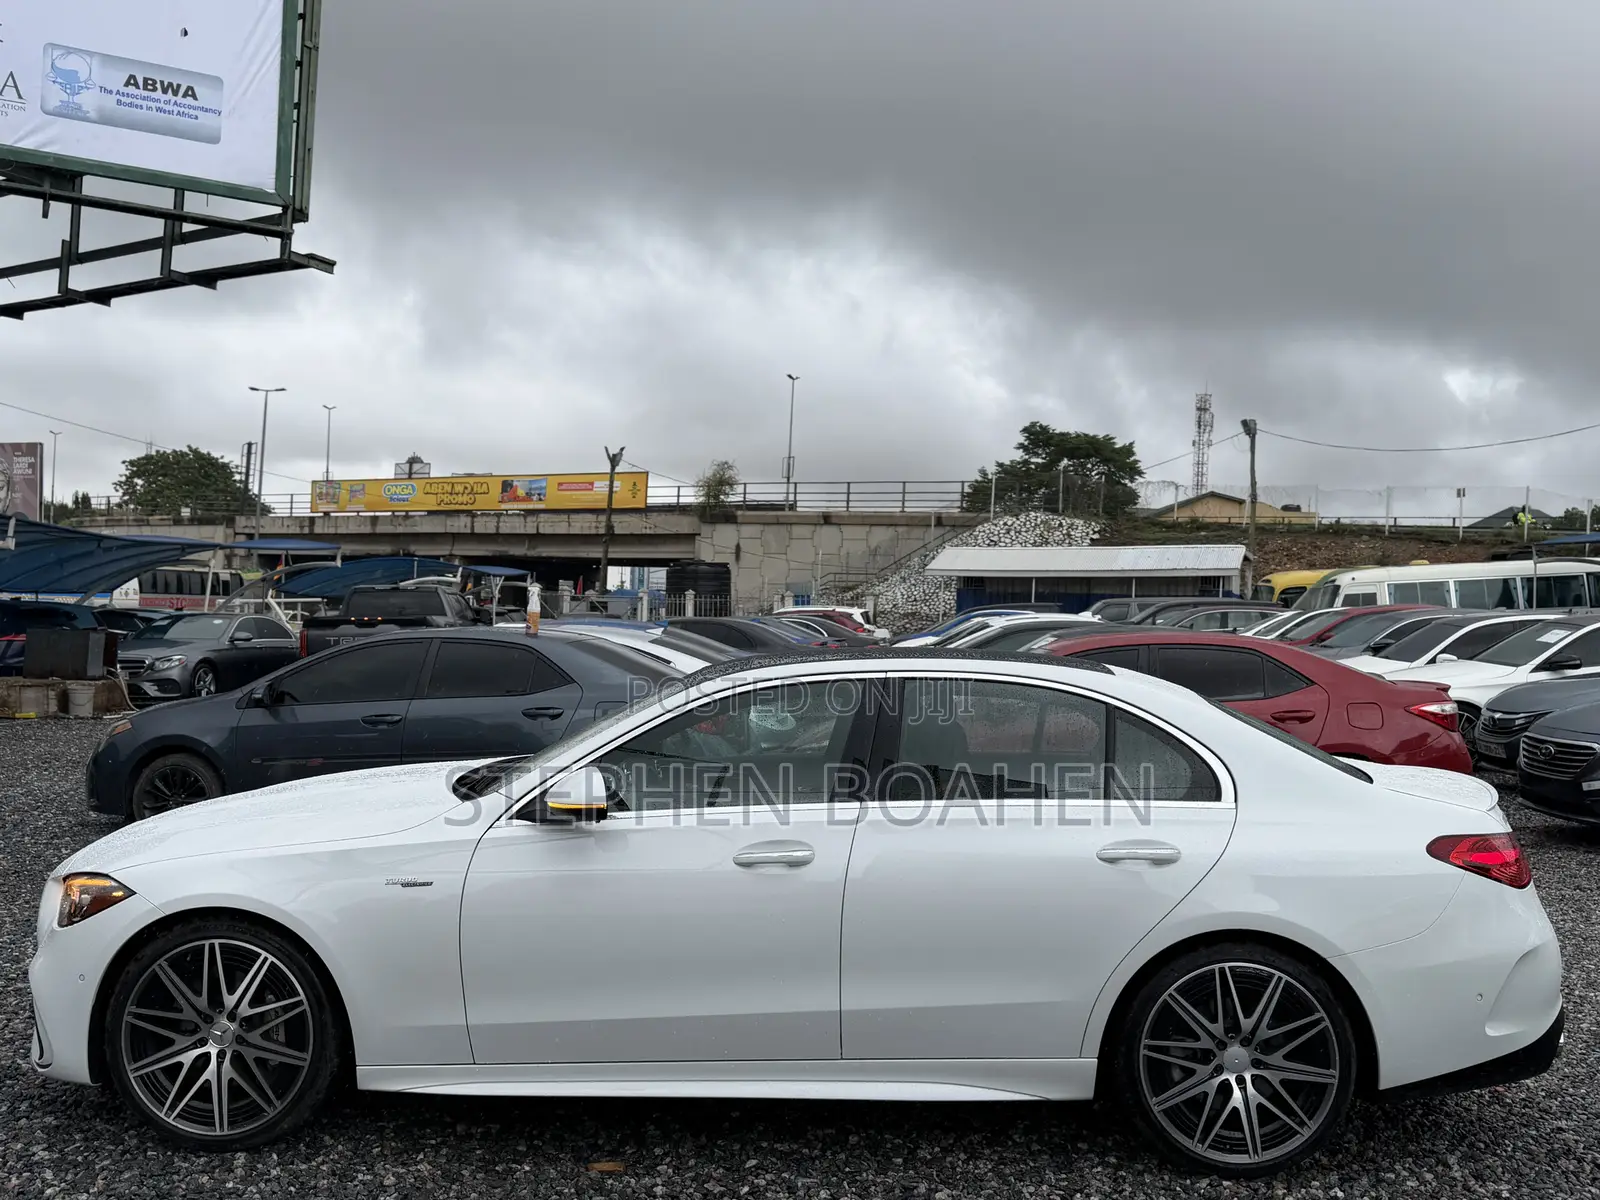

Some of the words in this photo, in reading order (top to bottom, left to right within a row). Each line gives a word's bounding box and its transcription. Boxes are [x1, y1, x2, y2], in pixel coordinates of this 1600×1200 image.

[123, 73, 199, 101] ABWA
[98, 86, 114, 96] The
[115, 89, 161, 104] Association
[163, 98, 172, 106] of
[172, 101, 222, 116] Accountancy
[116, 98, 144, 111] Bodies
[155, 106, 175, 116] West
[176, 110, 199, 120] Africa
[385, 485, 413, 495] ONGA
[436, 493, 476, 505] PROMO
